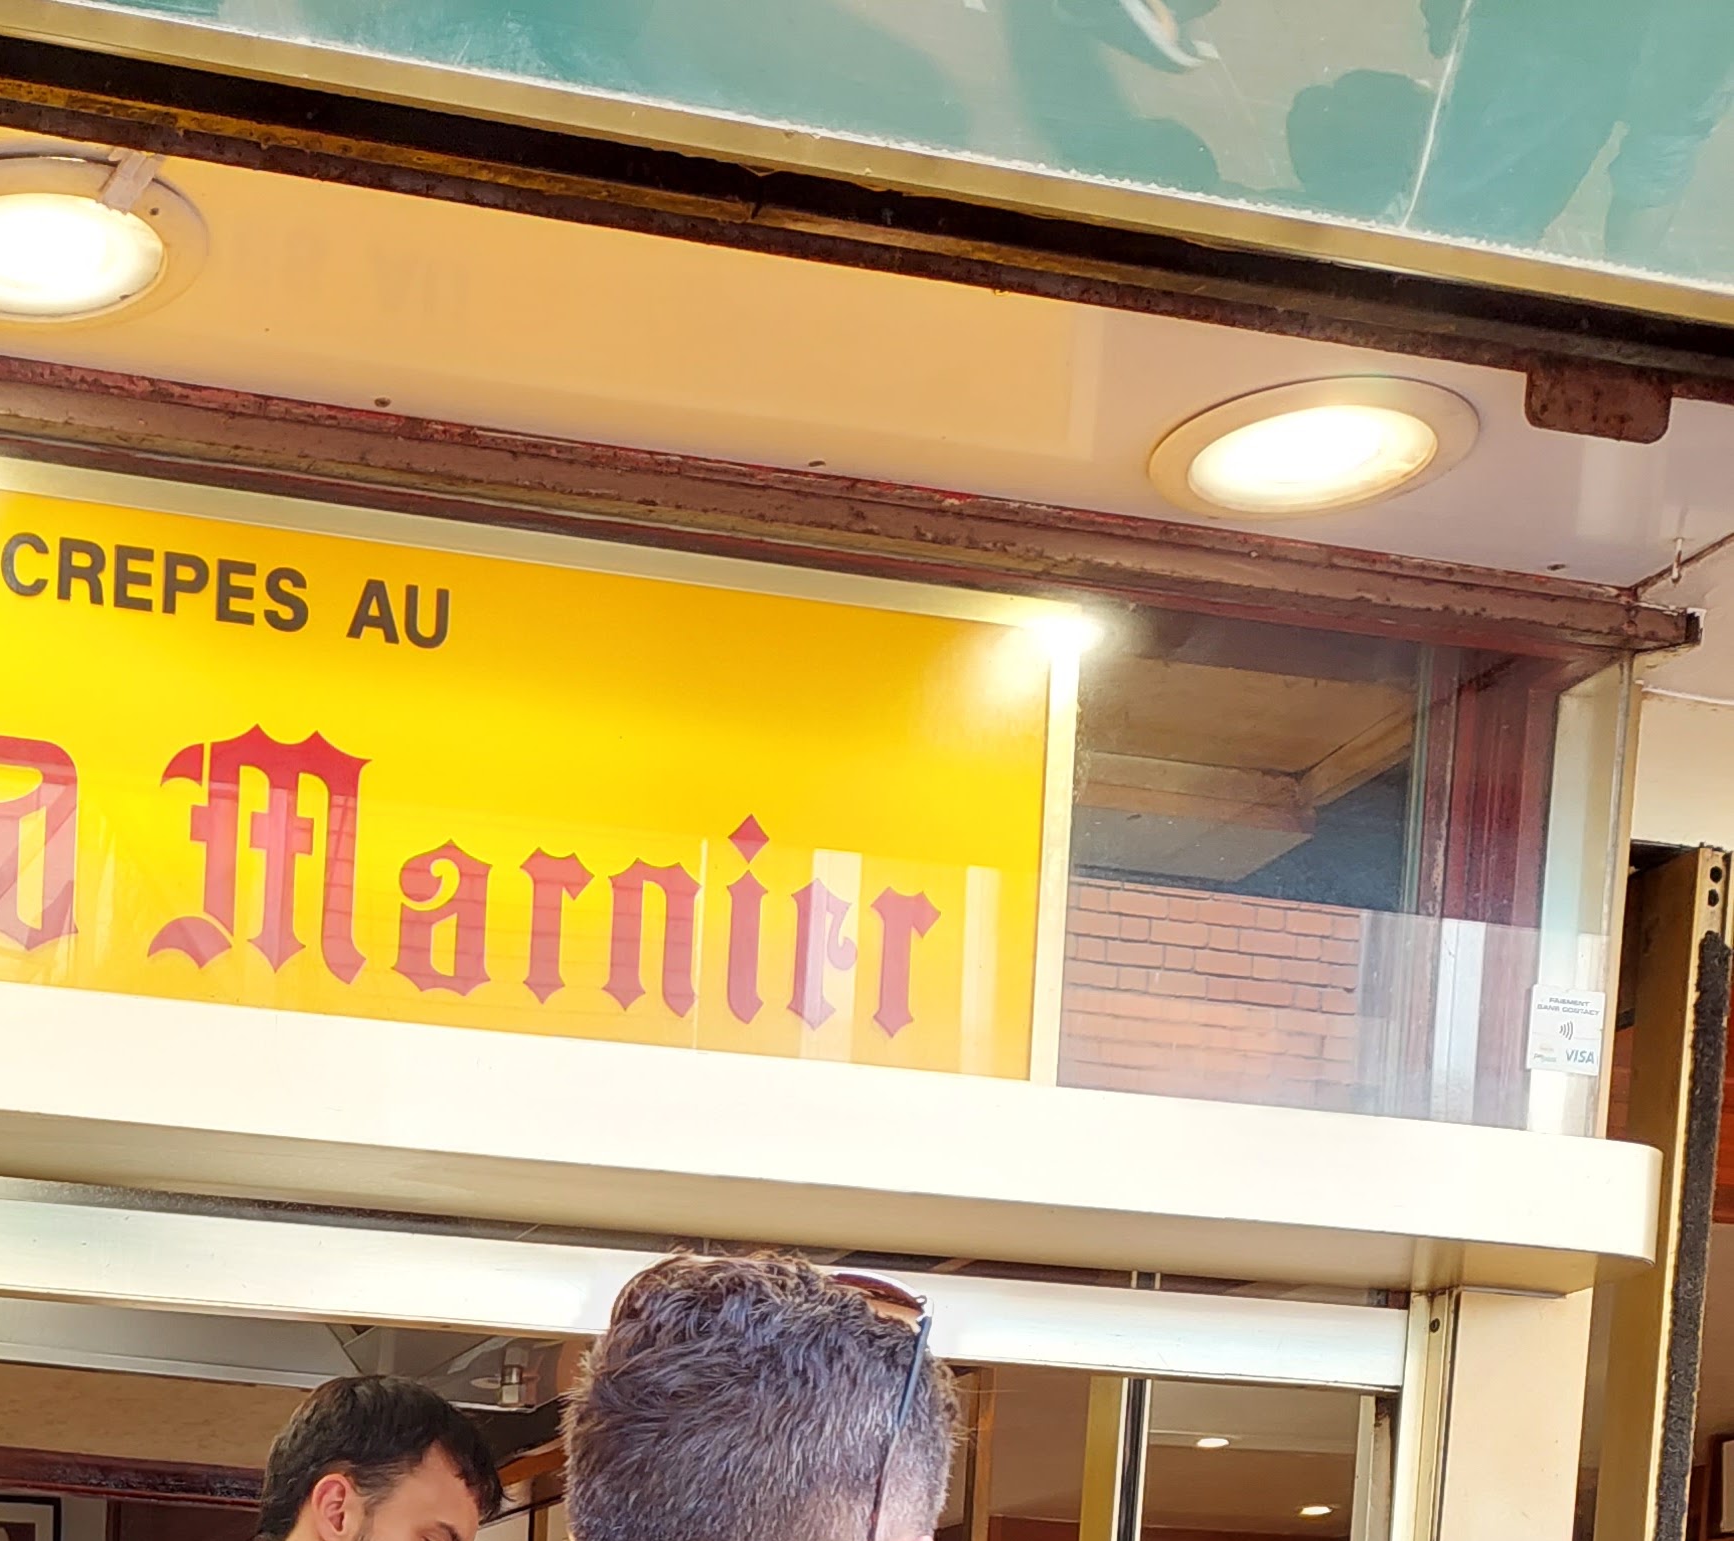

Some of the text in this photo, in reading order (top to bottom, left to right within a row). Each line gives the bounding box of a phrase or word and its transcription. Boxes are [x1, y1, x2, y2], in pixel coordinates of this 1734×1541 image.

[0, 531, 451, 649] CREPES AU
[146, 722, 942, 1039] Marnier
[1565, 1049, 1595, 1065] VISA
